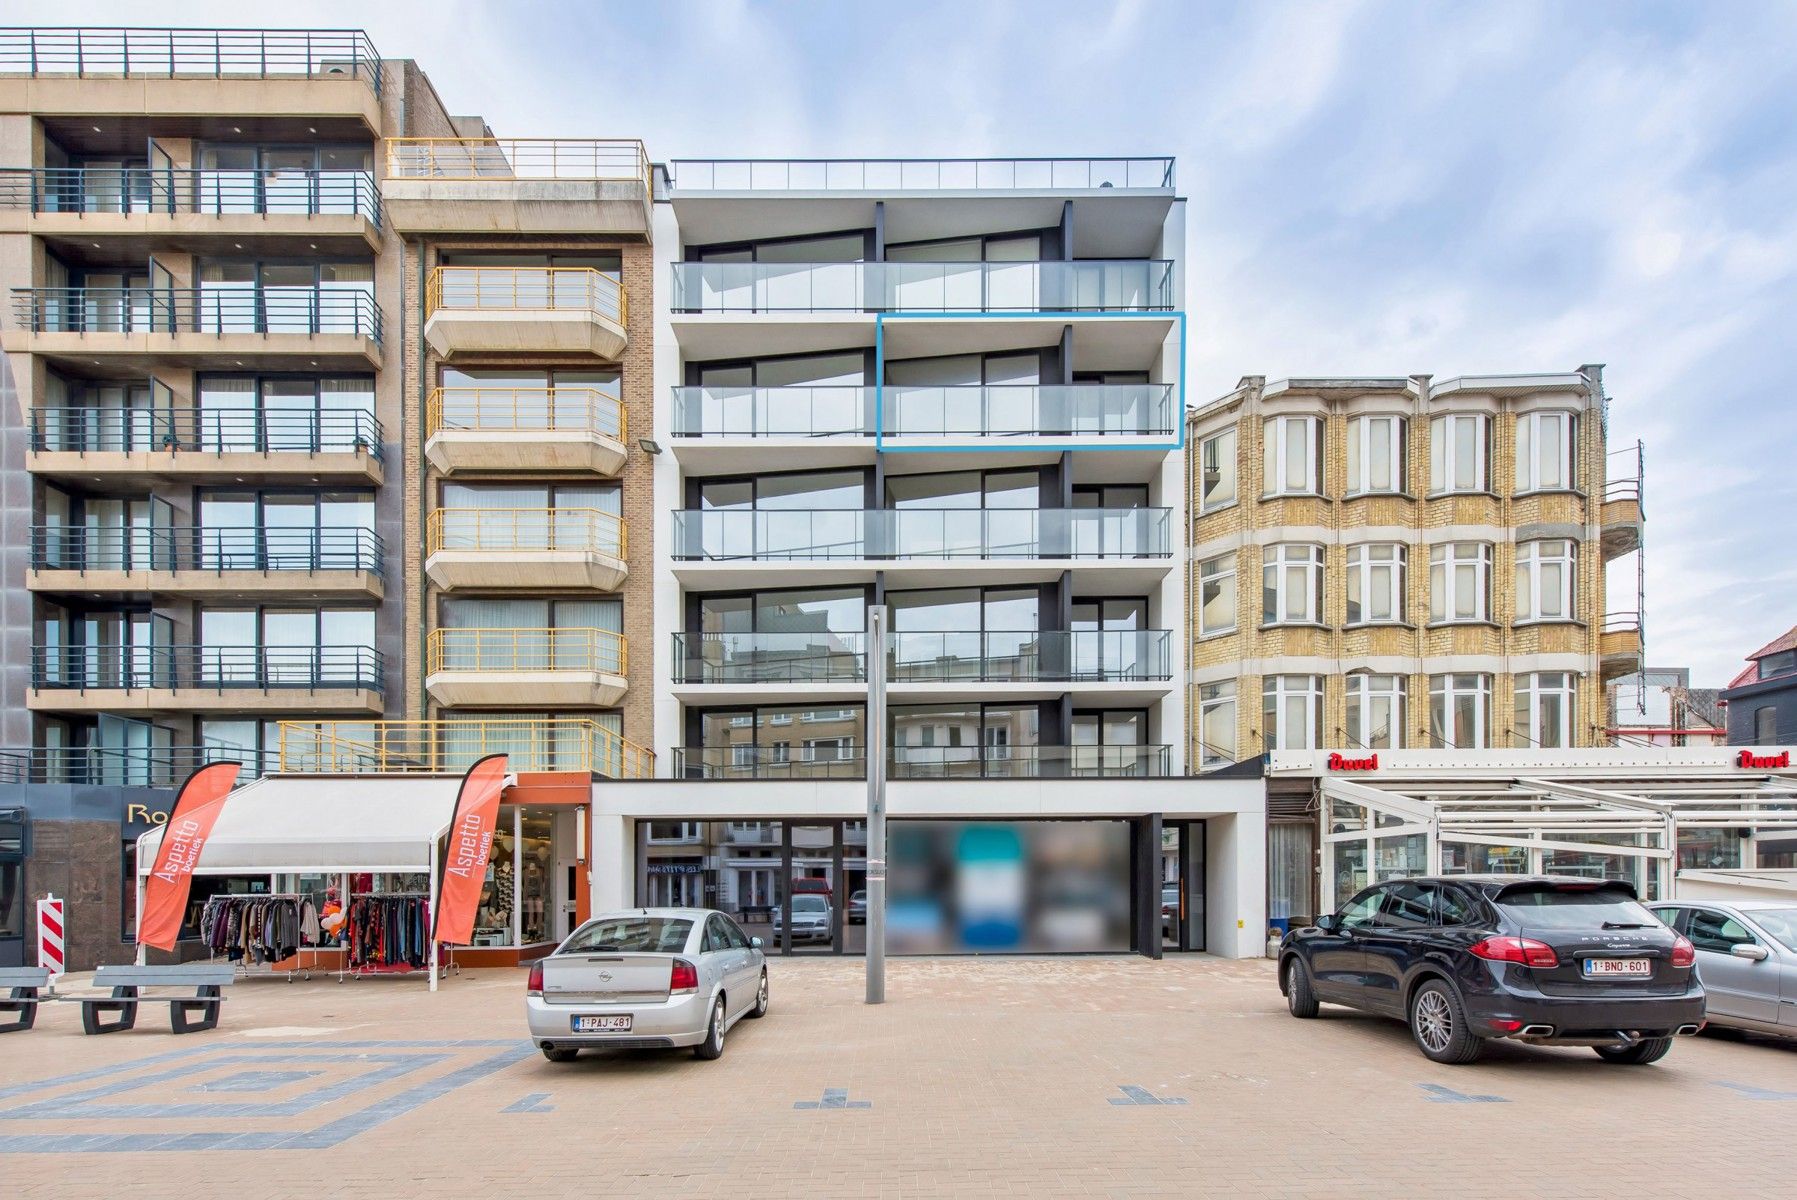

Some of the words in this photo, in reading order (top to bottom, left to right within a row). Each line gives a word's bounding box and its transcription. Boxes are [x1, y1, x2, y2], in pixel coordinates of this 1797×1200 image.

[1327, 752, 1378, 771] Duvel
[1736, 750, 1790, 768] Duvel
[127, 803, 170, 824] Ro
[153, 820, 199, 884] Aspetto
[181, 838, 204, 873] boetiek
[447, 814, 480, 878] Aspetto
[476, 831, 492, 866] boetiek
